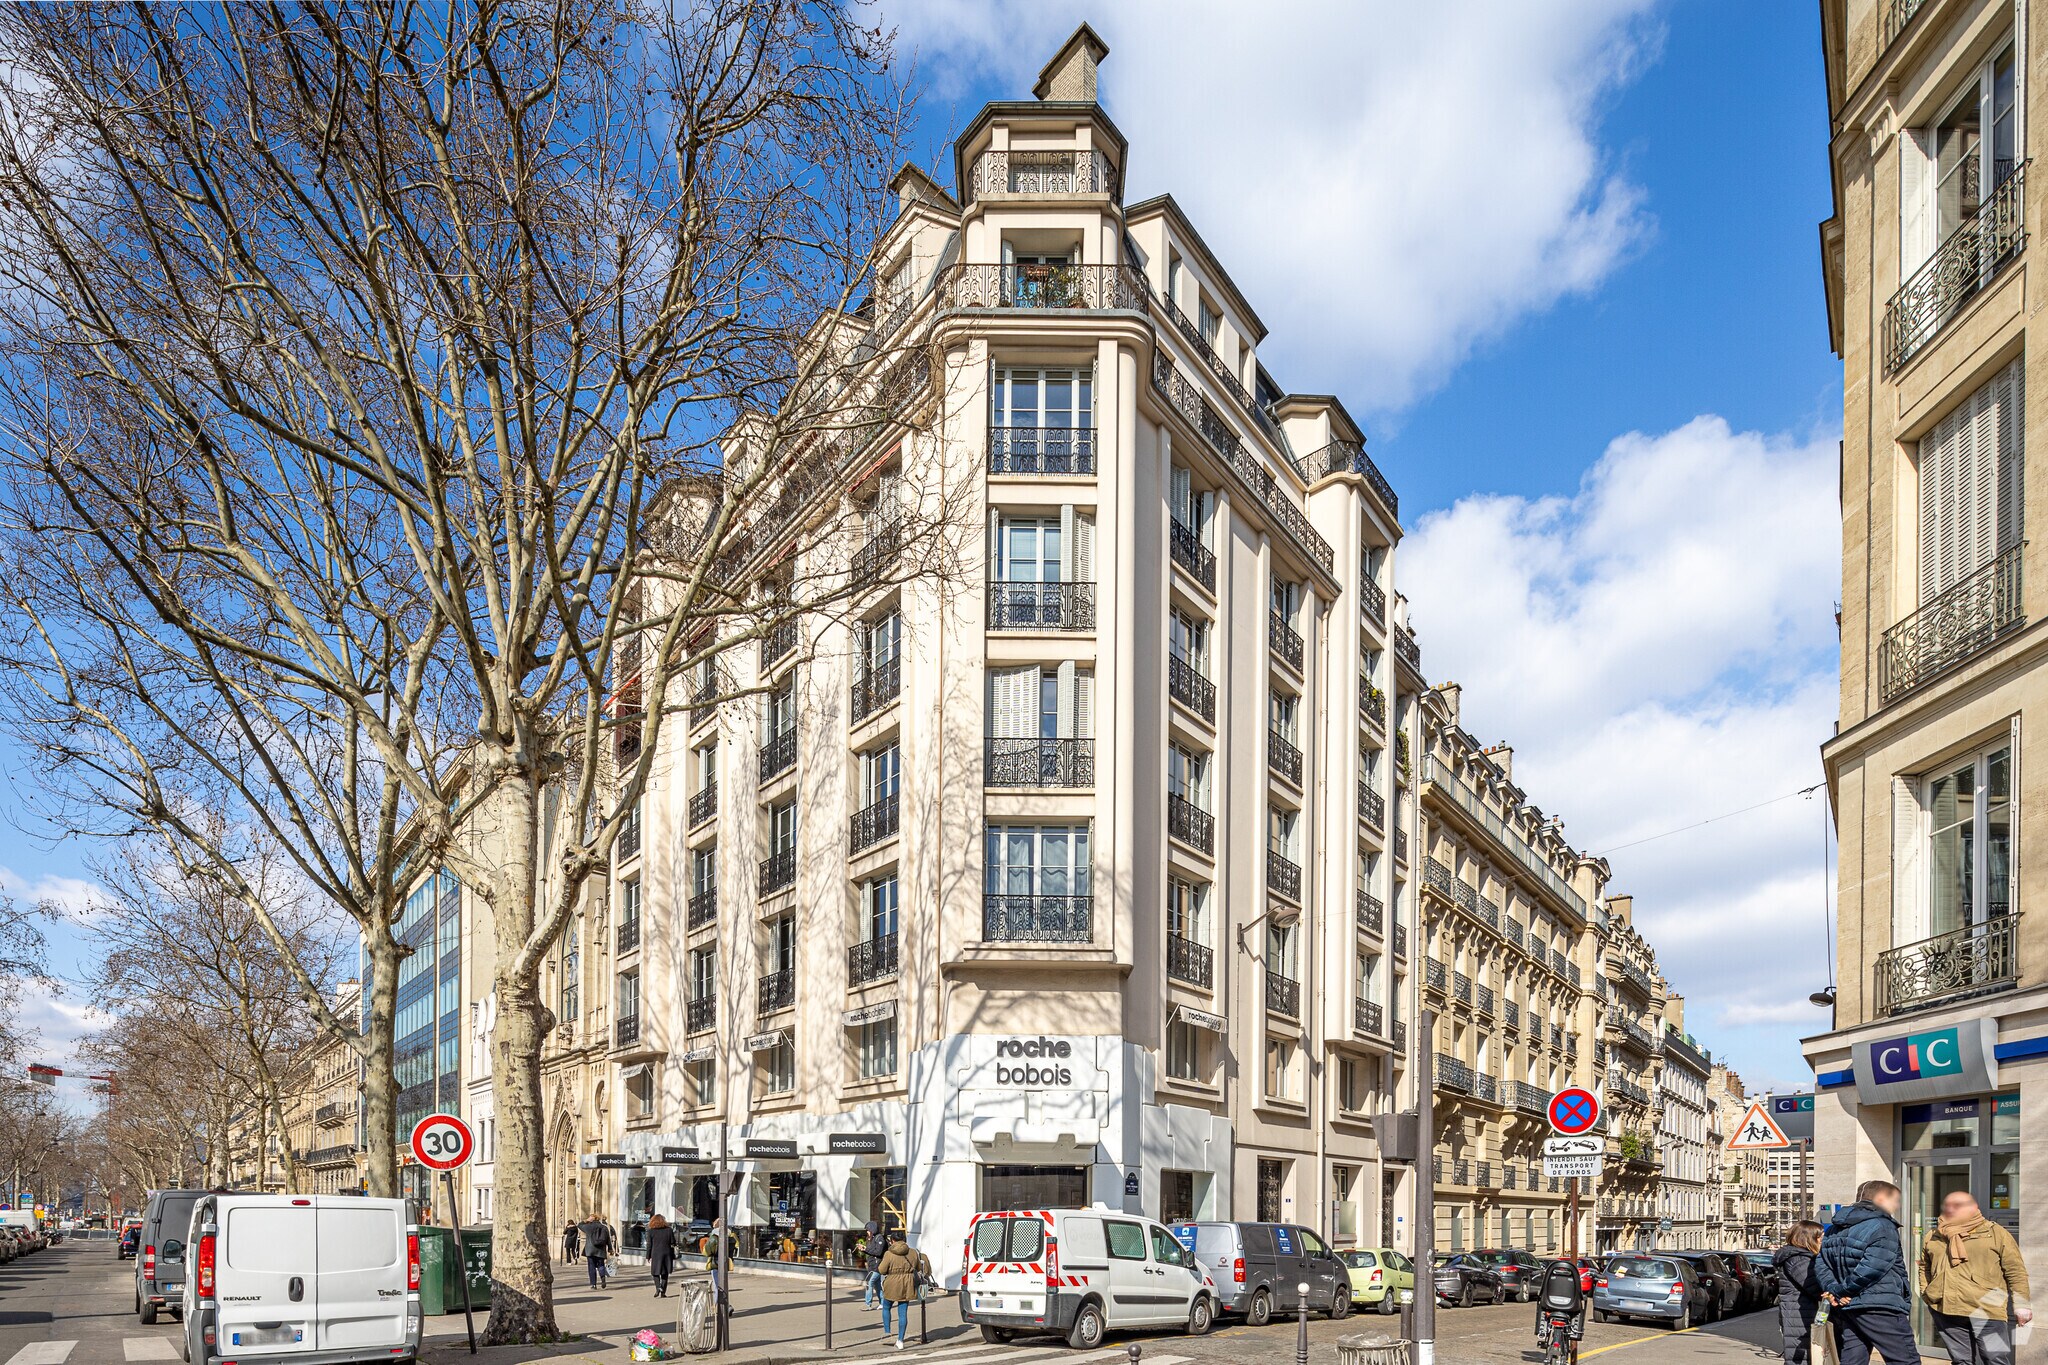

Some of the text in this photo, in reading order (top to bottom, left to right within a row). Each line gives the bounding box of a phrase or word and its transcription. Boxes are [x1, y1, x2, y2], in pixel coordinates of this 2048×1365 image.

[997, 1036, 1072, 1058] roche
[1879, 1038, 1952, 1075] CIC
[996, 1062, 1072, 1086] bobois
[1779, 1100, 1812, 1110] CIC
[2000, 1100, 2020, 1108] ASSU
[1945, 1105, 1973, 1114] BANQUE
[425, 1130, 461, 1155] 30
[832, 1140, 876, 1148] rochebobois
[749, 1145, 790, 1153] rochebobois
